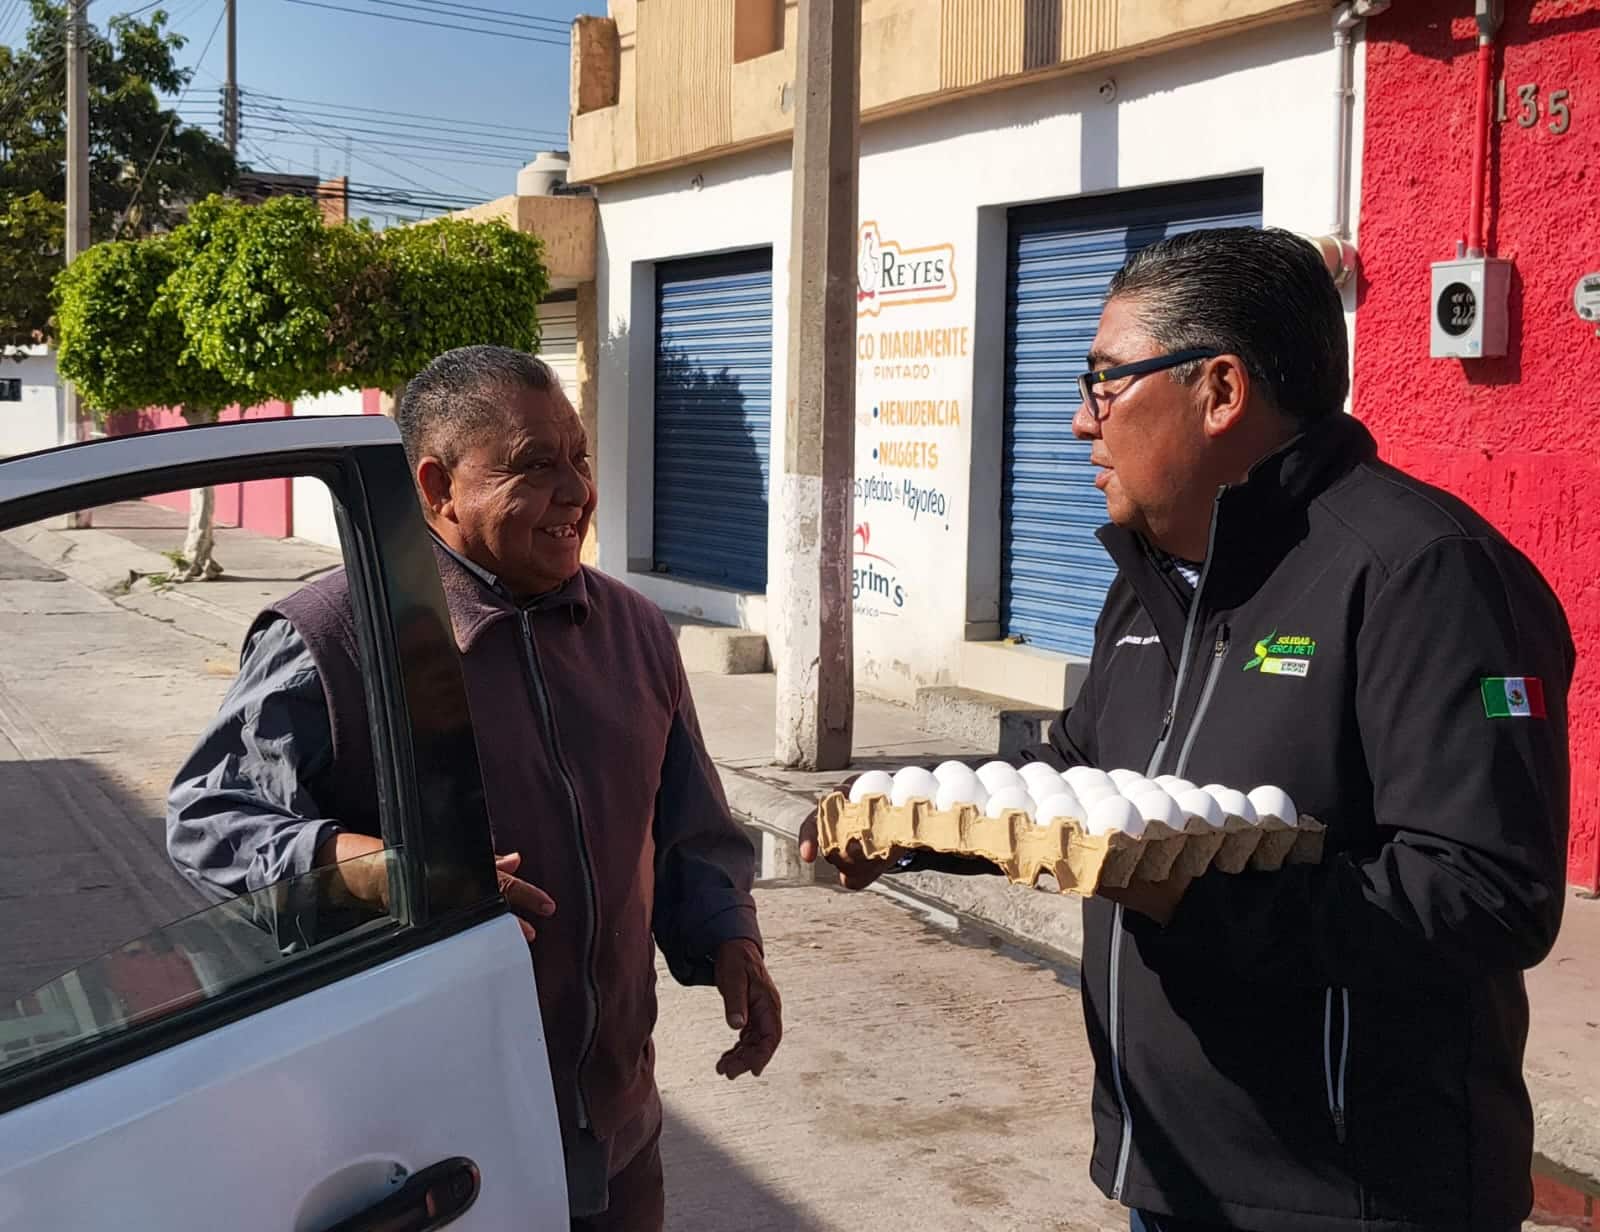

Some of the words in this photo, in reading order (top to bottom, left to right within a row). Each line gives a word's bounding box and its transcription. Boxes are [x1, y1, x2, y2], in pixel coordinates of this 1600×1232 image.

[1496, 80, 1570, 134] 135
[881, 251, 945, 288] REYES
[880, 326, 968, 360] DIARIAMENTE
[873, 364, 930, 380] PINTADO
[879, 440, 939, 470] NUGGETS
